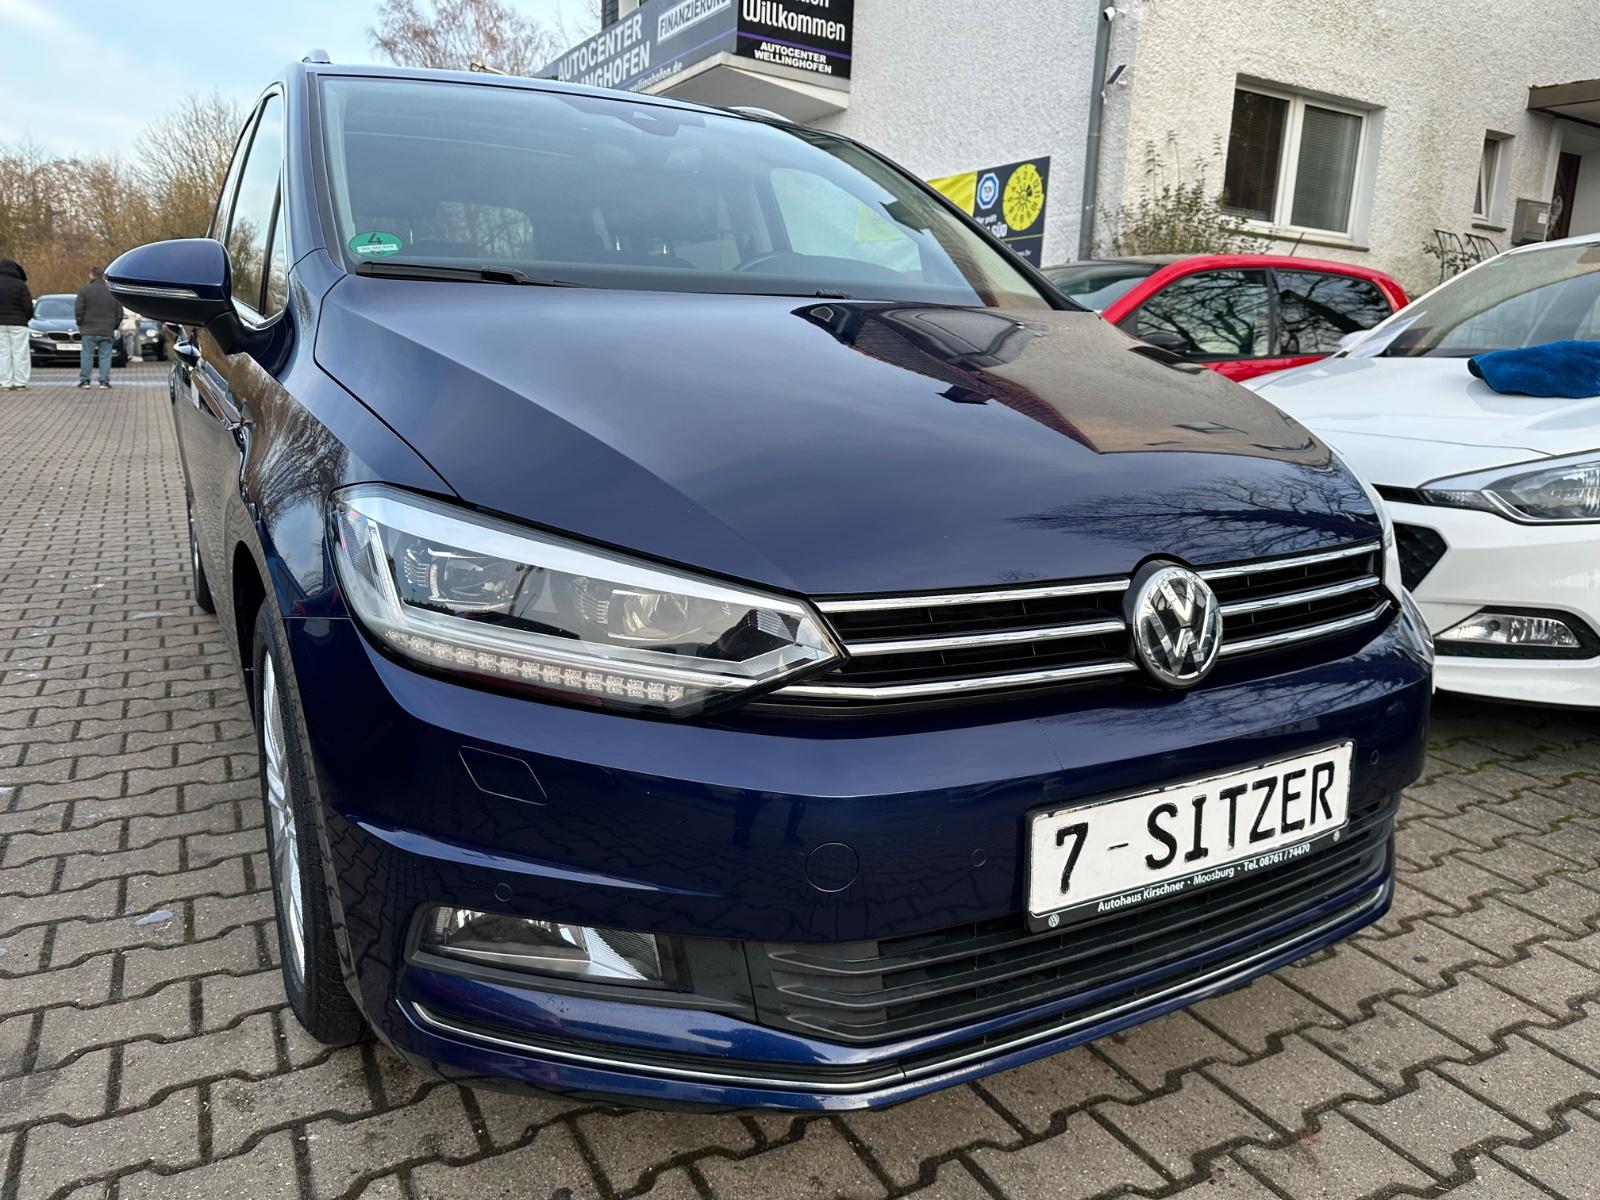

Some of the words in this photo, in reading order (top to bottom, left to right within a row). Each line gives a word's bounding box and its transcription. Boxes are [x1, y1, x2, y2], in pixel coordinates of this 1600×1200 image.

[660, 0, 726, 38] FINANZIERU
[742, 0, 845, 42] Willkommen
[558, 13, 641, 81] AUTOCENTER
[754, 49, 832, 74] WELLINGHOFEN
[760, 41, 827, 64] AUTOCENTER
[367, 232, 384, 244] 4
[1055, 821, 1089, 895] 7
[1144, 760, 1335, 870] SITZER
[1097, 892, 1142, 912] Autohaus
[1142, 880, 1185, 900] Kirschner
[1193, 866, 1235, 886] Moosburg
[1243, 860, 1260, 872] Tel.
[1259, 853, 1284, 868] 08761
[1288, 844, 1311, 860] 74470
